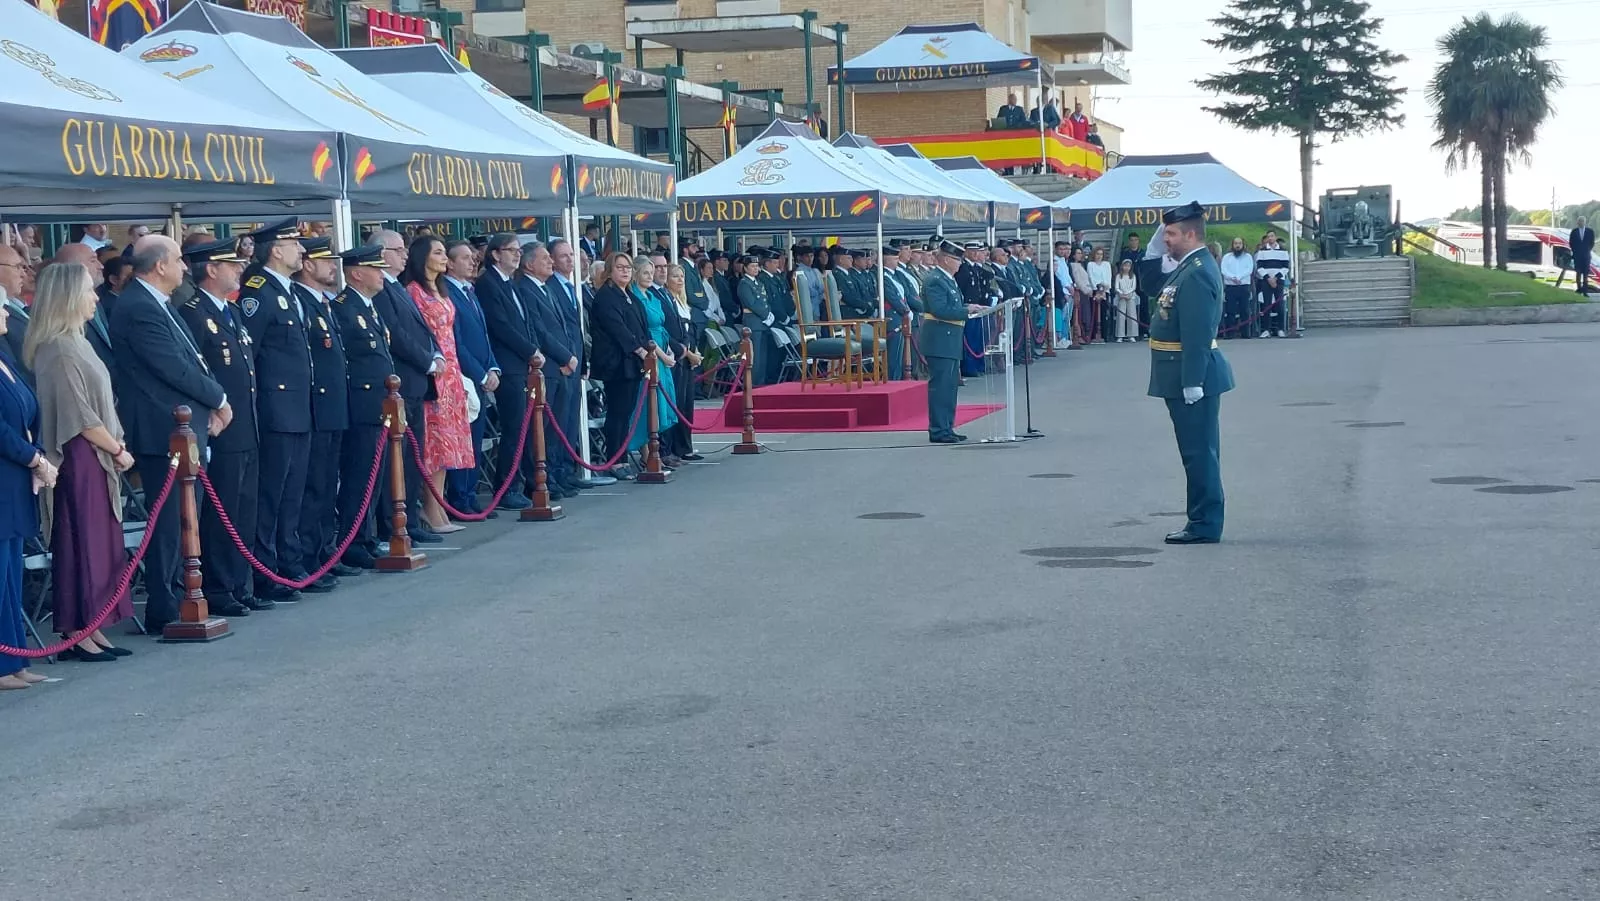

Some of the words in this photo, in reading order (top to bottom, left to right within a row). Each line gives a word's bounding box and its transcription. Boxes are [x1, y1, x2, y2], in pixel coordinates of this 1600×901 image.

[875, 66, 943, 82] GUARDIA
[948, 63, 988, 77] CIVIL
[61, 117, 203, 182] GUARDIA
[204, 132, 275, 185] CIVIL
[407, 151, 487, 199] GUARDIA
[487, 158, 530, 200] CIVIL
[593, 166, 638, 199] GUARDIA
[639, 170, 664, 202] CIVIL
[779, 197, 842, 219] CIVIL
[1095, 208, 1164, 227] GUARDI
[1203, 205, 1232, 221] VIL
